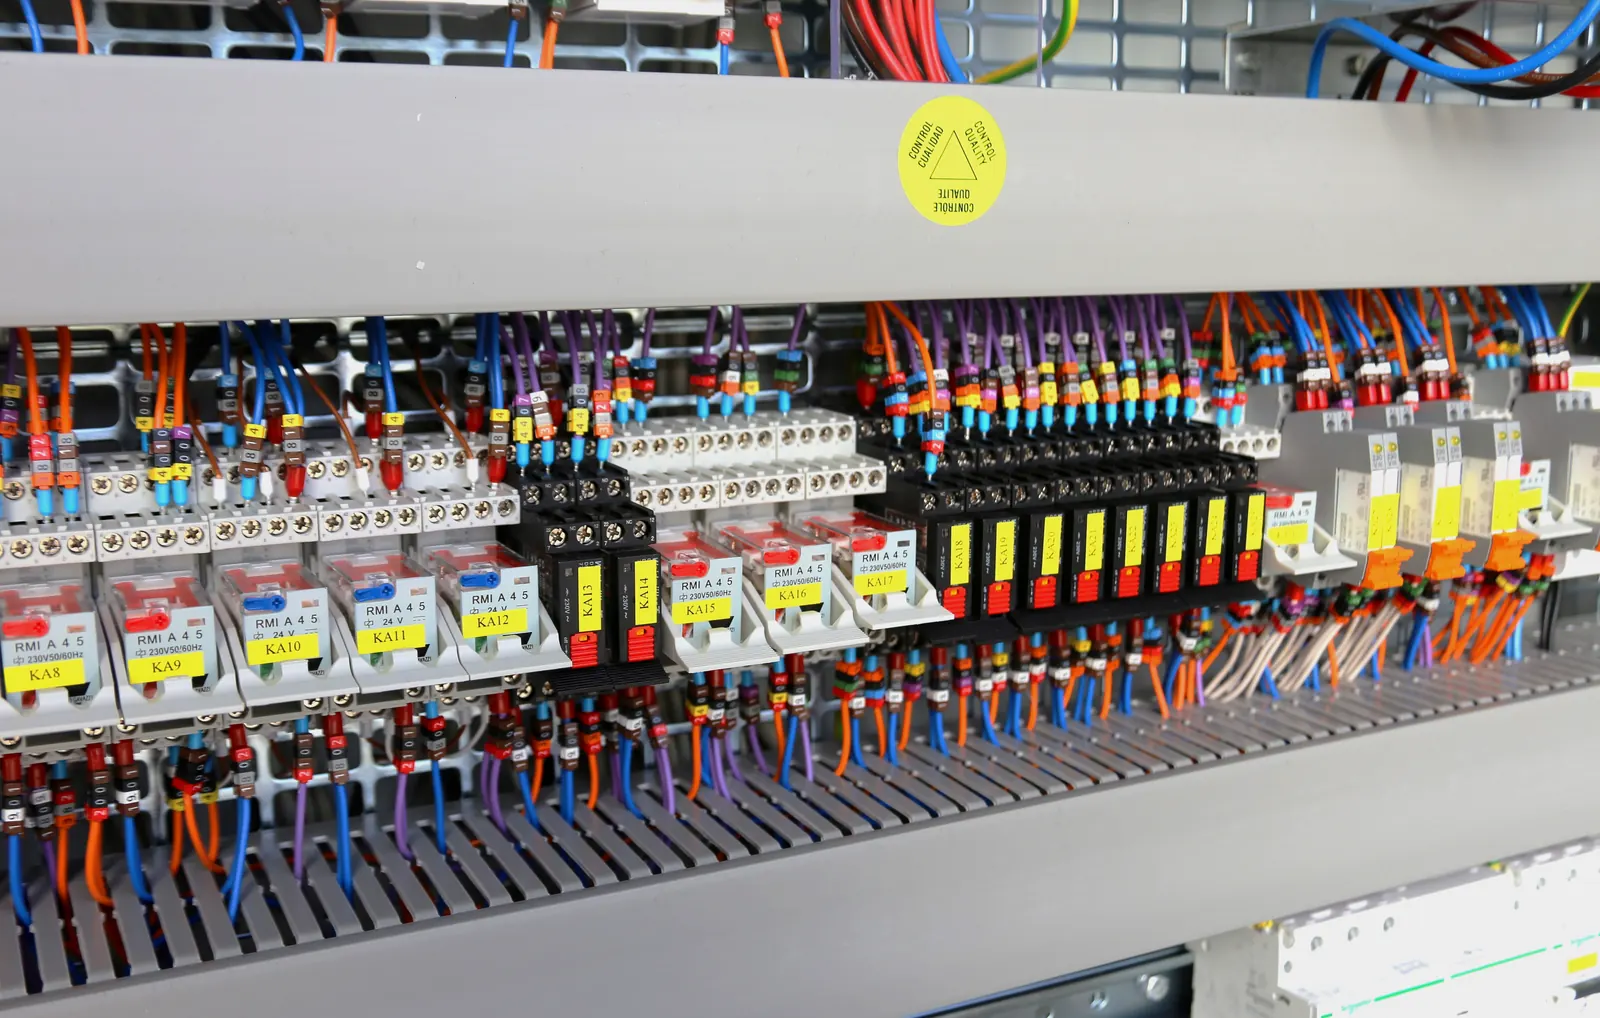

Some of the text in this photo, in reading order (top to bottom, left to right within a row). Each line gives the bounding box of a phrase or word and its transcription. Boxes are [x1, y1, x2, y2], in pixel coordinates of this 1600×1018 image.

[908, 121, 933, 160] CONTROL
[918, 126, 944, 168] CUALIDAD
[964, 128, 987, 166] QUALITY
[974, 120, 996, 162] CONTROL
[1046, 532, 1056, 560] KA20
[862, 554, 880, 562] RMI
[883, 552, 890, 560] A
[892, 551, 898, 559] 4
[954, 540, 964, 569] KA18
[774, 569, 792, 578] RMI
[796, 567, 804, 575] A
[817, 564, 822, 572] 5
[682, 582, 700, 591] RMI
[705, 580, 712, 588] A
[727, 578, 732, 586] 5
[867, 576, 893, 588] KA17
[472, 591, 528, 605] RMI A 4 5
[582, 584, 593, 617] KA13
[639, 577, 649, 610] KA14
[780, 588, 807, 600] KA16
[366, 602, 426, 616] RMI A 4 5
[686, 602, 716, 616] KA15
[256, 614, 318, 628] RMI A 4 5
[477, 614, 509, 628] KA12
[138, 630, 203, 646] RMI A 4 5
[373, 630, 406, 644] KA11
[15, 636, 84, 653] RMI A 4 5
[149, 643, 203, 656] 230V50/60Hz
[266, 640, 301, 656] KA10
[28, 651, 84, 664] 230V50/60Hz
[29, 666, 60, 682] KA8
[152, 660, 182, 674] KA9
